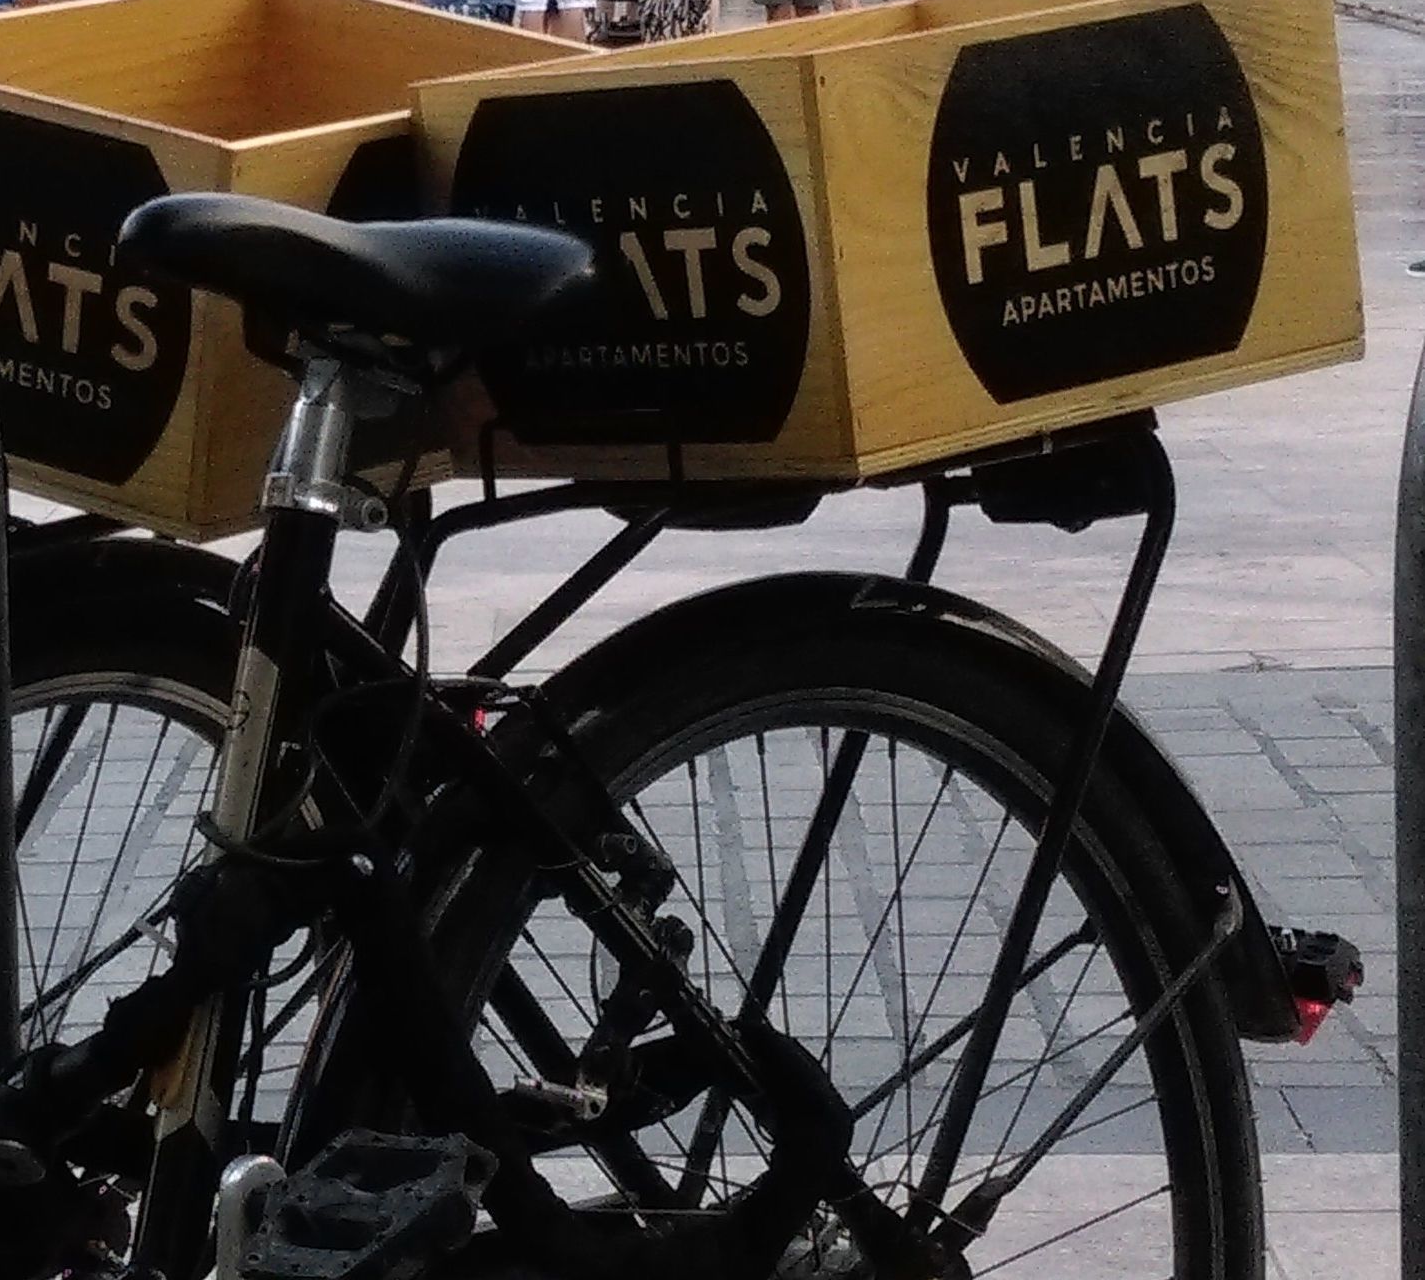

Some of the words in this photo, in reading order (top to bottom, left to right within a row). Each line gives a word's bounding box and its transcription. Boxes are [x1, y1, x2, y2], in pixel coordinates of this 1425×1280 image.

[952, 106, 1234, 183] VALENCIA
[958, 143, 1244, 285] FLATS
[620, 227, 782, 320] ATS
[1002, 256, 1216, 327] APARTAMENTOS
